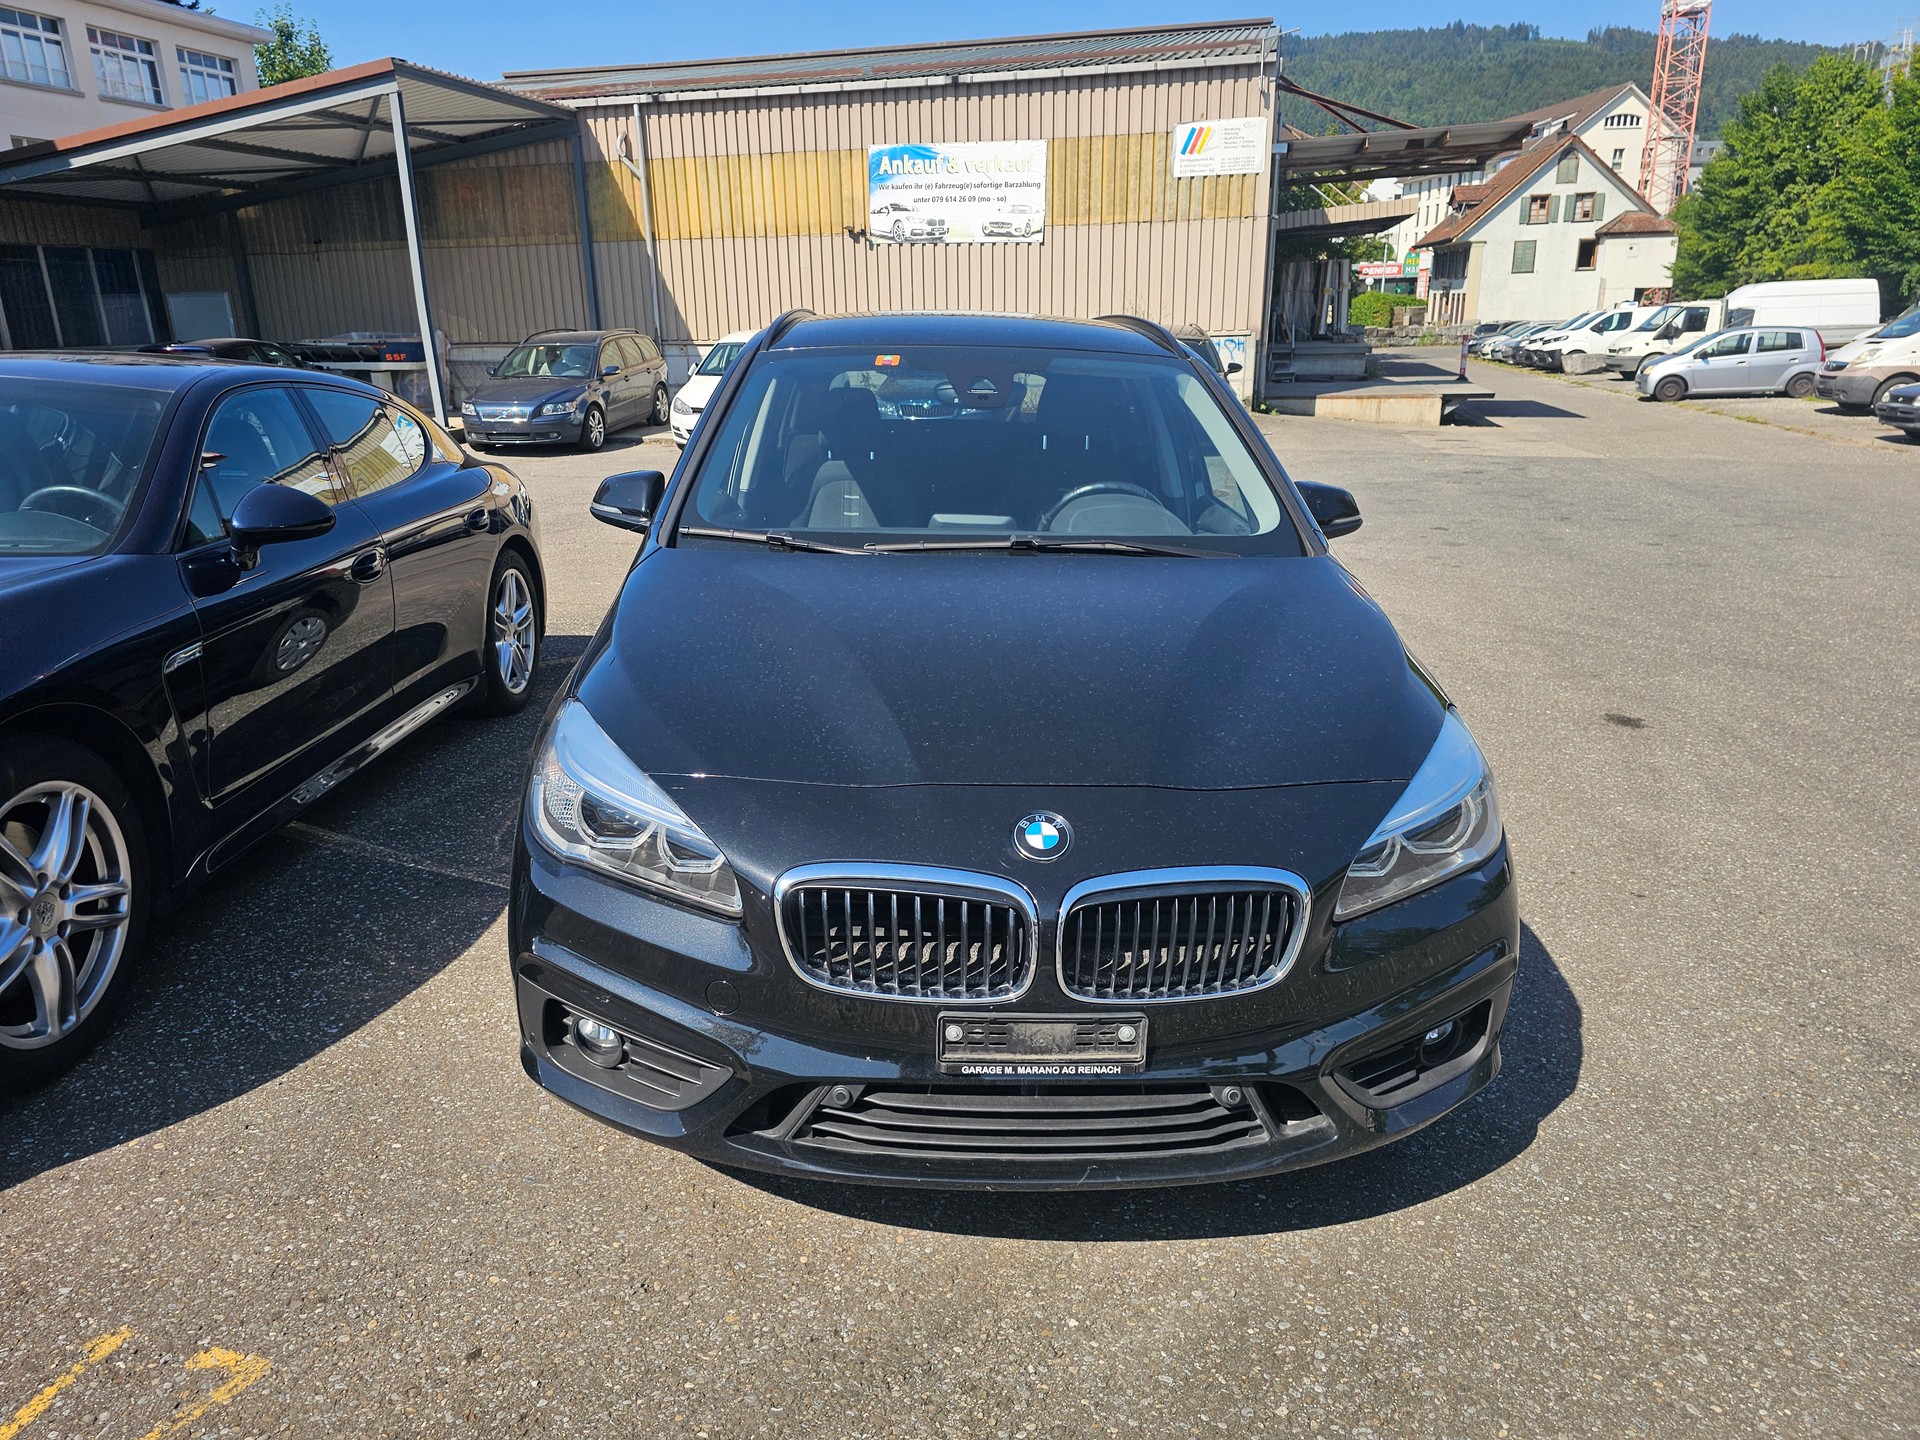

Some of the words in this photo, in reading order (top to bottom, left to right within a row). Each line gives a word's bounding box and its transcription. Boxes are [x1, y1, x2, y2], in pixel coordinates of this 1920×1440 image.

[878, 153, 945, 175] Ankauf
[946, 156, 960, 174] &
[973, 182, 1002, 190] sofortige
[1004, 181, 1041, 189] Barzahlung
[1020, 815, 1064, 829] BMW
[961, 1066, 1003, 1074] GARAGE
[1004, 1066, 1015, 1074] M.
[1018, 1066, 1060, 1074] MARANO
[1062, 1066, 1076, 1074] AG
[1078, 1066, 1121, 1074] REINACH
